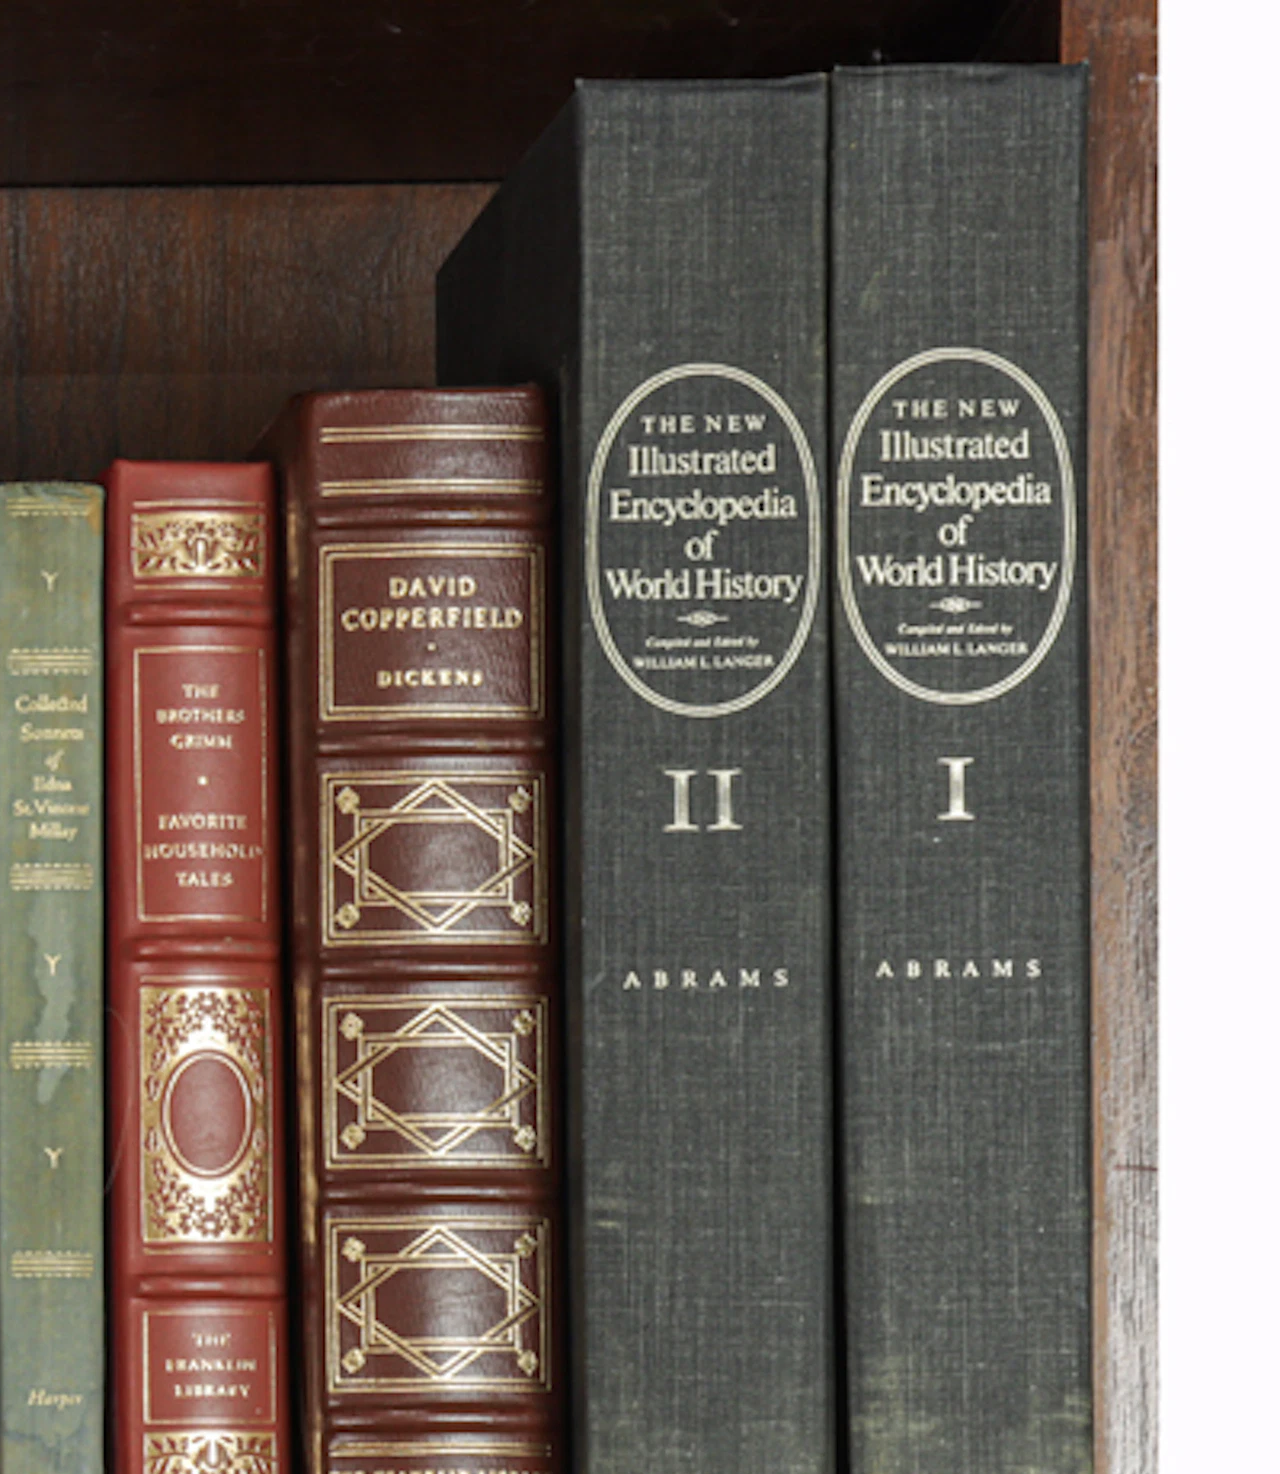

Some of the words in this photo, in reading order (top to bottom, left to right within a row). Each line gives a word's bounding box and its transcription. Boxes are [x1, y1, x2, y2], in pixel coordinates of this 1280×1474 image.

[893, 399, 948, 419] THE
[958, 398, 1020, 417] NEW
[642, 415, 695, 434] THE
[705, 414, 766, 433] NEW
[880, 428, 1030, 462] Illustrated
[627, 443, 777, 477] Illustrated
[860, 472, 1052, 512] Encyclopedia
[609, 486, 797, 526] Encyclopedia
[938, 513, 974, 546] of
[684, 529, 720, 561] of
[857, 554, 943, 587] World
[949, 553, 1057, 591] History
[389, 576, 477, 599] DAVID
[606, 568, 689, 600] World
[695, 567, 803, 603] History
[341, 606, 523, 631] COPPERFIELD
[885, 642, 950, 656] WILLIAM
[966, 641, 1028, 656] LANGER
[634, 656, 697, 669] WILLIAM
[714, 654, 774, 669] LANGER
[376, 668, 484, 687] DICKENS
[182, 683, 219, 698] THE
[156, 708, 245, 724] BROTHERS
[169, 734, 233, 749] GRIMM
[937, 756, 975, 821] I
[661, 767, 743, 833] II
[158, 814, 248, 830] FAVORITE
[176, 871, 234, 887] TALES
[623, 967, 790, 990] ABRAMS
[876, 957, 1042, 979] ABRAMS
[192, 1332, 231, 1347] THE
[165, 1358, 257, 1372] FRANKLIN
[27, 1389, 83, 1411] Harper
[174, 1384, 250, 1397] LIBRARY
